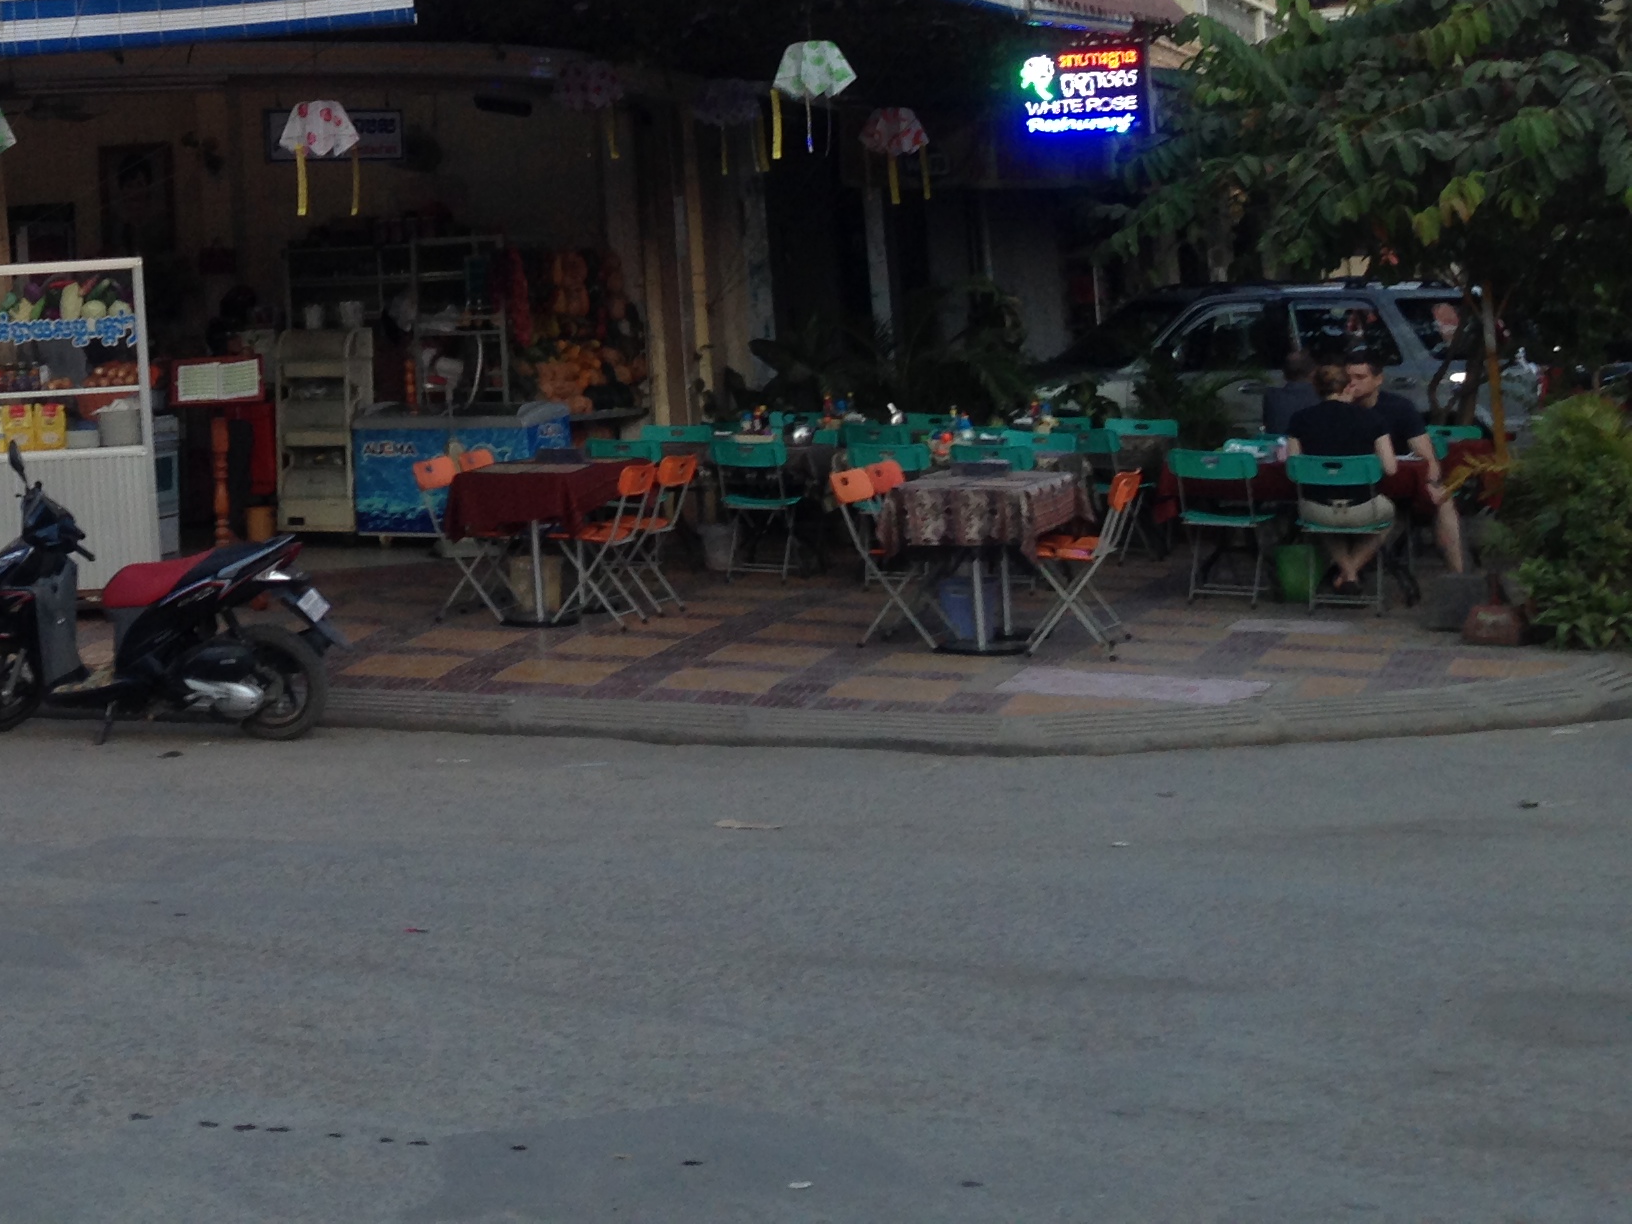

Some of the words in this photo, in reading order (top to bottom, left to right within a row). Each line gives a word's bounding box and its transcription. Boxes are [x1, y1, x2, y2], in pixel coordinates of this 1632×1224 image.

[1025, 98, 1084, 116] WHITE
[1085, 95, 1138, 112] ROSE
[1026, 113, 1136, 133] Restaurant
